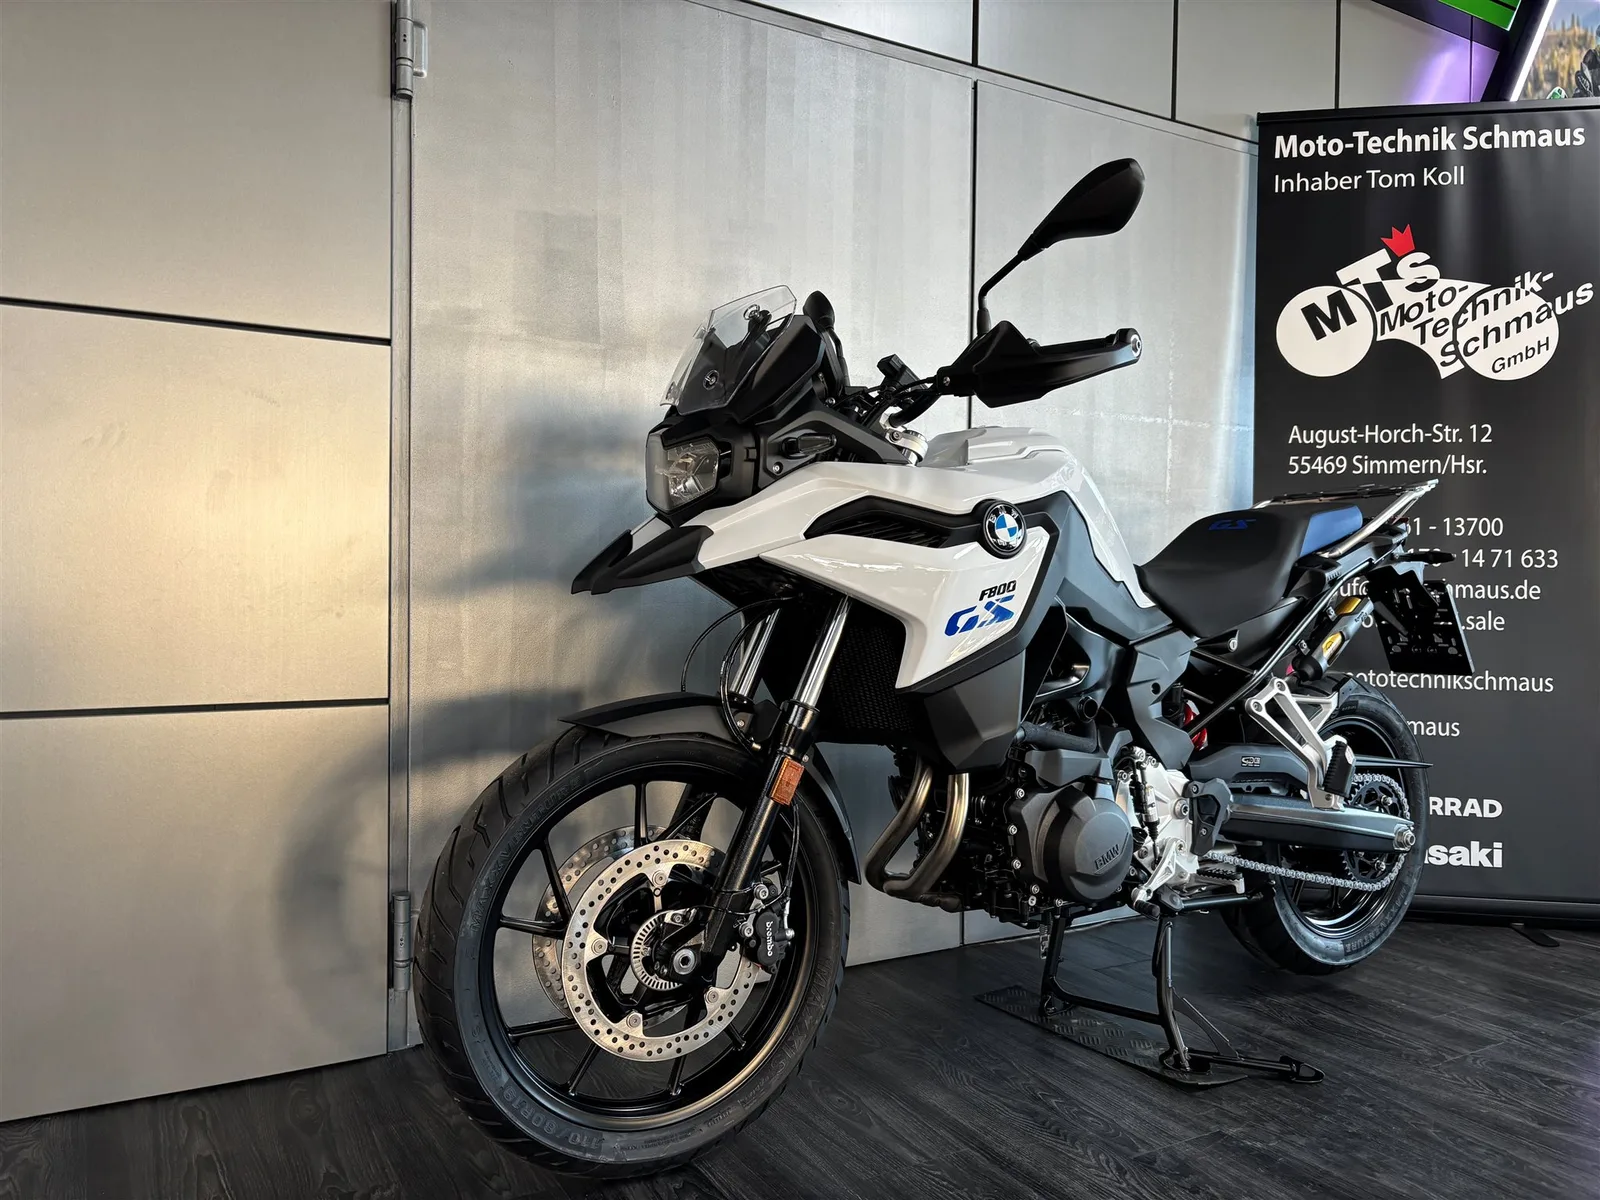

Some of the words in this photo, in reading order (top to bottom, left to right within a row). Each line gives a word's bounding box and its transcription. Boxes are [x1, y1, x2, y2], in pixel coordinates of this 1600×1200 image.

[1274, 126, 1457, 159] Moto-Technik
[1463, 124, 1586, 150] Schmaus
[1274, 171, 1362, 193] Inhaber
[1366, 170, 1415, 189] Tom
[1424, 166, 1465, 186] Koll
[1379, 284, 1469, 336] Moto-
[1413, 270, 1554, 346] Technik-
[1439, 281, 1594, 368] Schmaus
[1491, 336, 1550, 374] GmbH
[1288, 423, 1463, 448] August-Horch-Str.
[1470, 424, 1493, 443] 12
[1288, 455, 1347, 474] 55469
[1352, 455, 1487, 475] Simmern/Hsr.
[1443, 517, 1504, 537] 13700
[1462, 549, 1486, 568] 14
[1491, 549, 1512, 568] 71
[1520, 549, 1559, 569] 633
[979, 580, 1017, 601] F800
[944, 594, 1015, 637] GS
[1347, 669, 1554, 692] ototechnikschmaus
[1093, 843, 1120, 870] BMW
[1424, 840, 1503, 868] saki
[765, 920, 775, 957] brembo
[502, 1084, 604, 1152] 110/80R19
